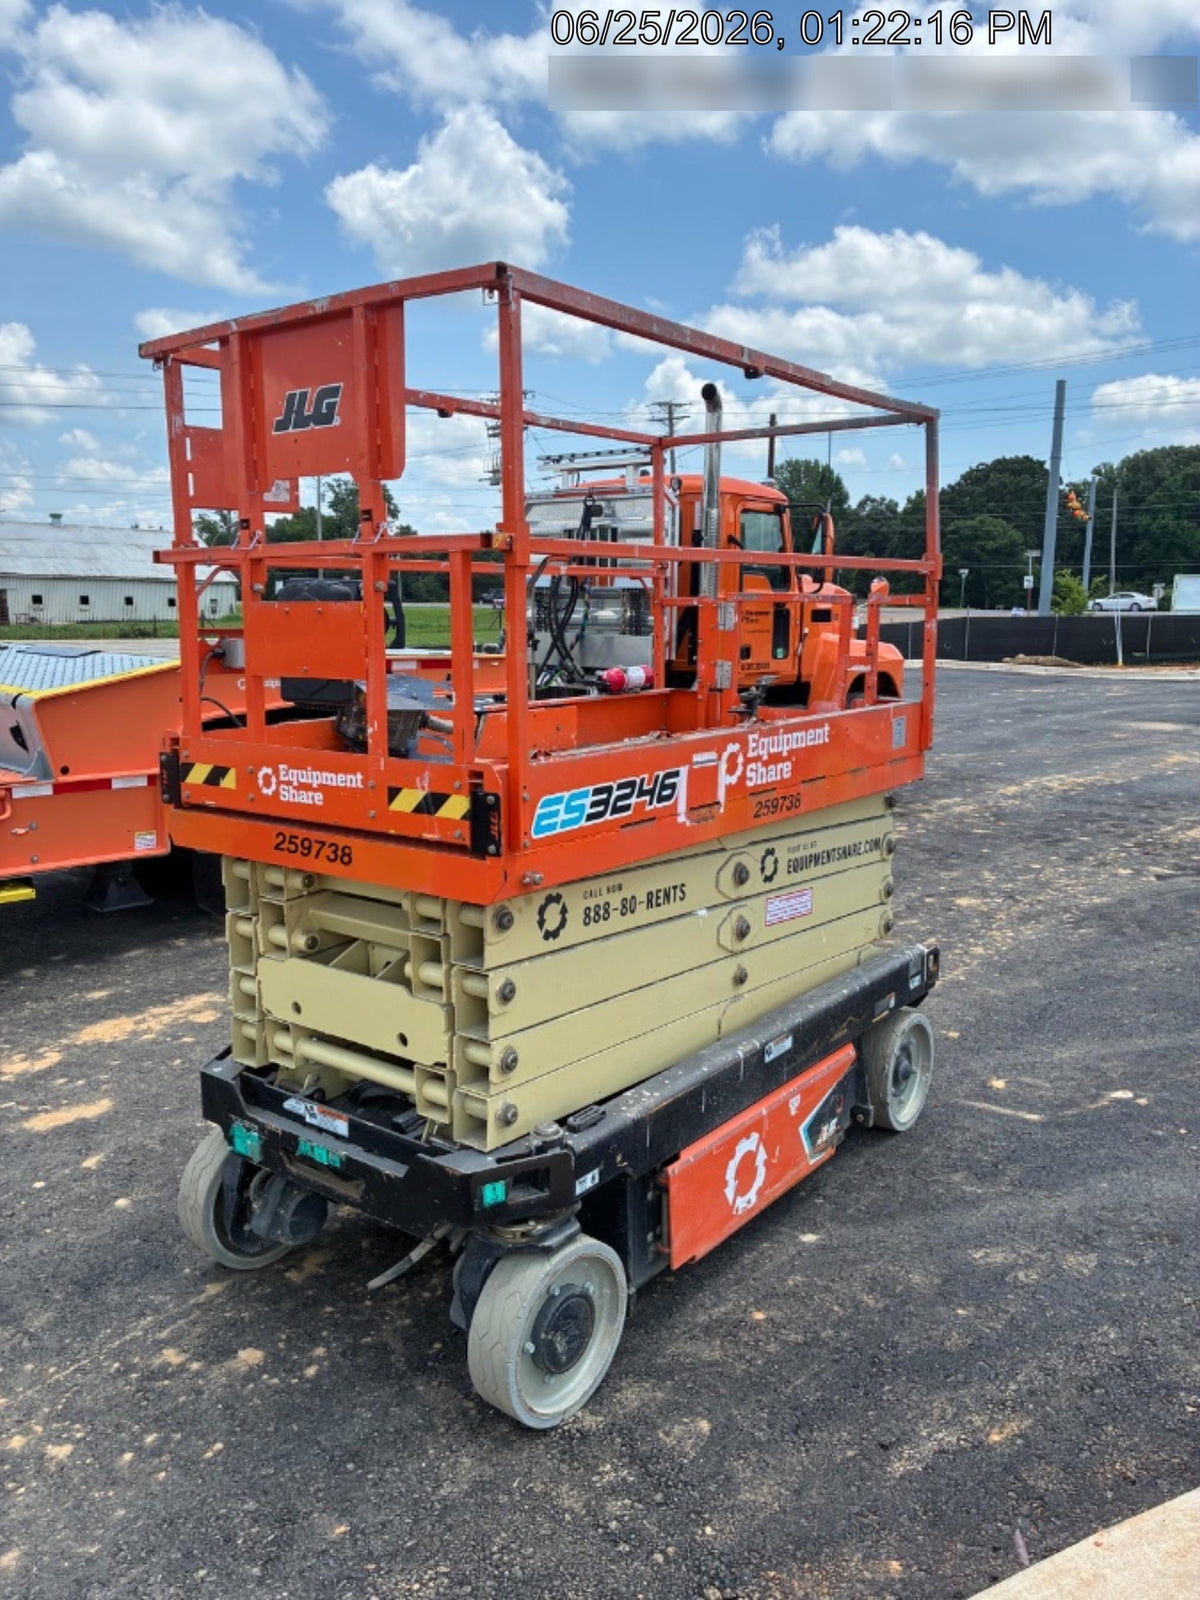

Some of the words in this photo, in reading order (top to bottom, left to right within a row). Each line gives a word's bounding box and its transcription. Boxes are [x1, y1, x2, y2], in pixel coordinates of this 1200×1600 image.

[272, 382, 343, 436] JLG
[747, 723, 830, 760] Equipment
[278, 764, 364, 788] Equipment
[746, 761, 792, 787] Share
[280, 784, 324, 806] Share
[532, 768, 681, 838] ES3246
[753, 793, 801, 819] 259738
[273, 832, 353, 866] 259738
[787, 837, 881, 875] EQUIPMENTSHARE.COM
[583, 888, 603, 900] CALL
[583, 883, 686, 926] 888-80-RENTS
